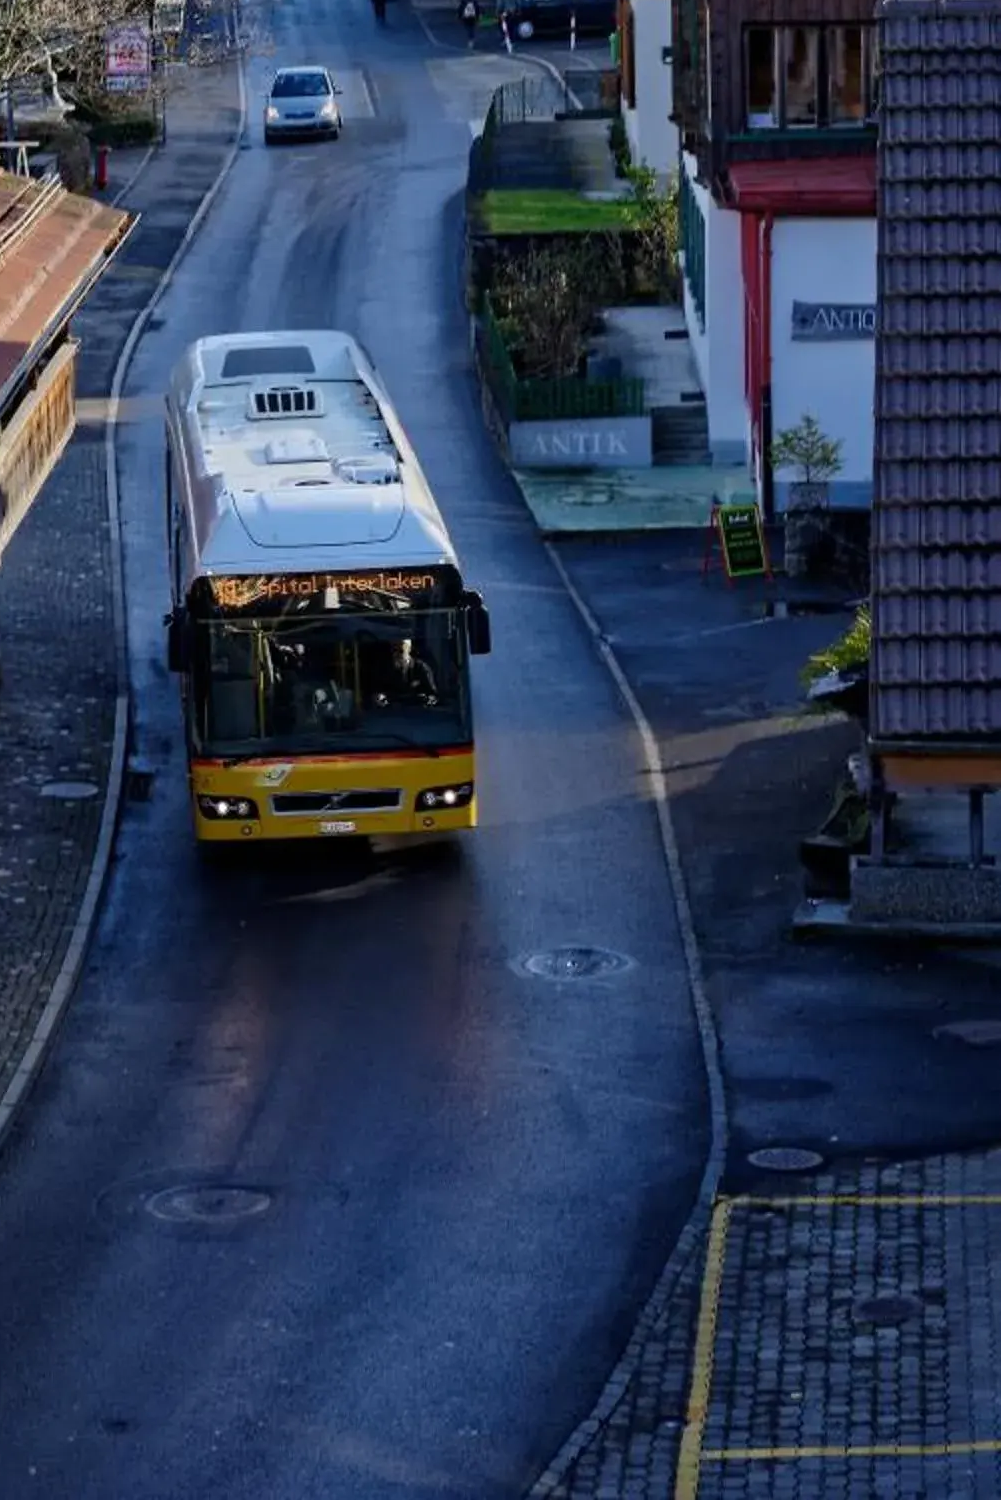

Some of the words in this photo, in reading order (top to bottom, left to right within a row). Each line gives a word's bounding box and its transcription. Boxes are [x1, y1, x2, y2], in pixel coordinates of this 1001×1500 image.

[531, 429, 629, 455] ANTIK
[259, 575, 320, 598] Spital
[325, 573, 435, 592] Interlaken
